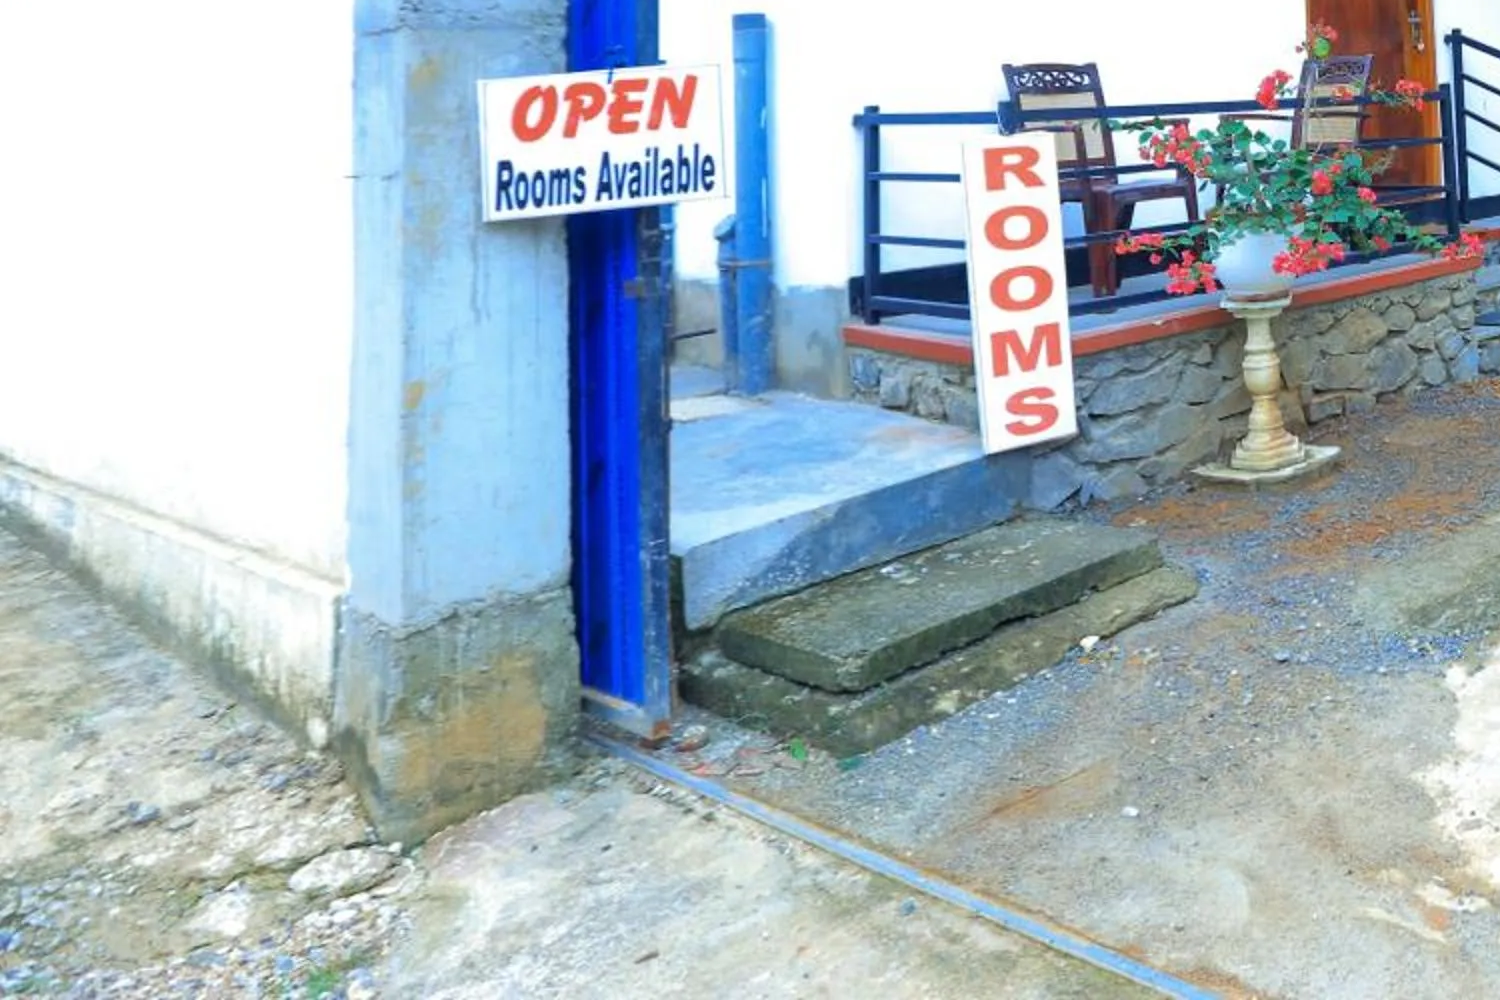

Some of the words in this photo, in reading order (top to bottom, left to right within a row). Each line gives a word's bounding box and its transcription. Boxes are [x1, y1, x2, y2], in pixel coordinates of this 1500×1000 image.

[511, 74, 698, 142] OPEN
[495, 160, 587, 211] Rooms
[595, 143, 715, 201] Available
[982, 146, 1063, 436] ROOMS
